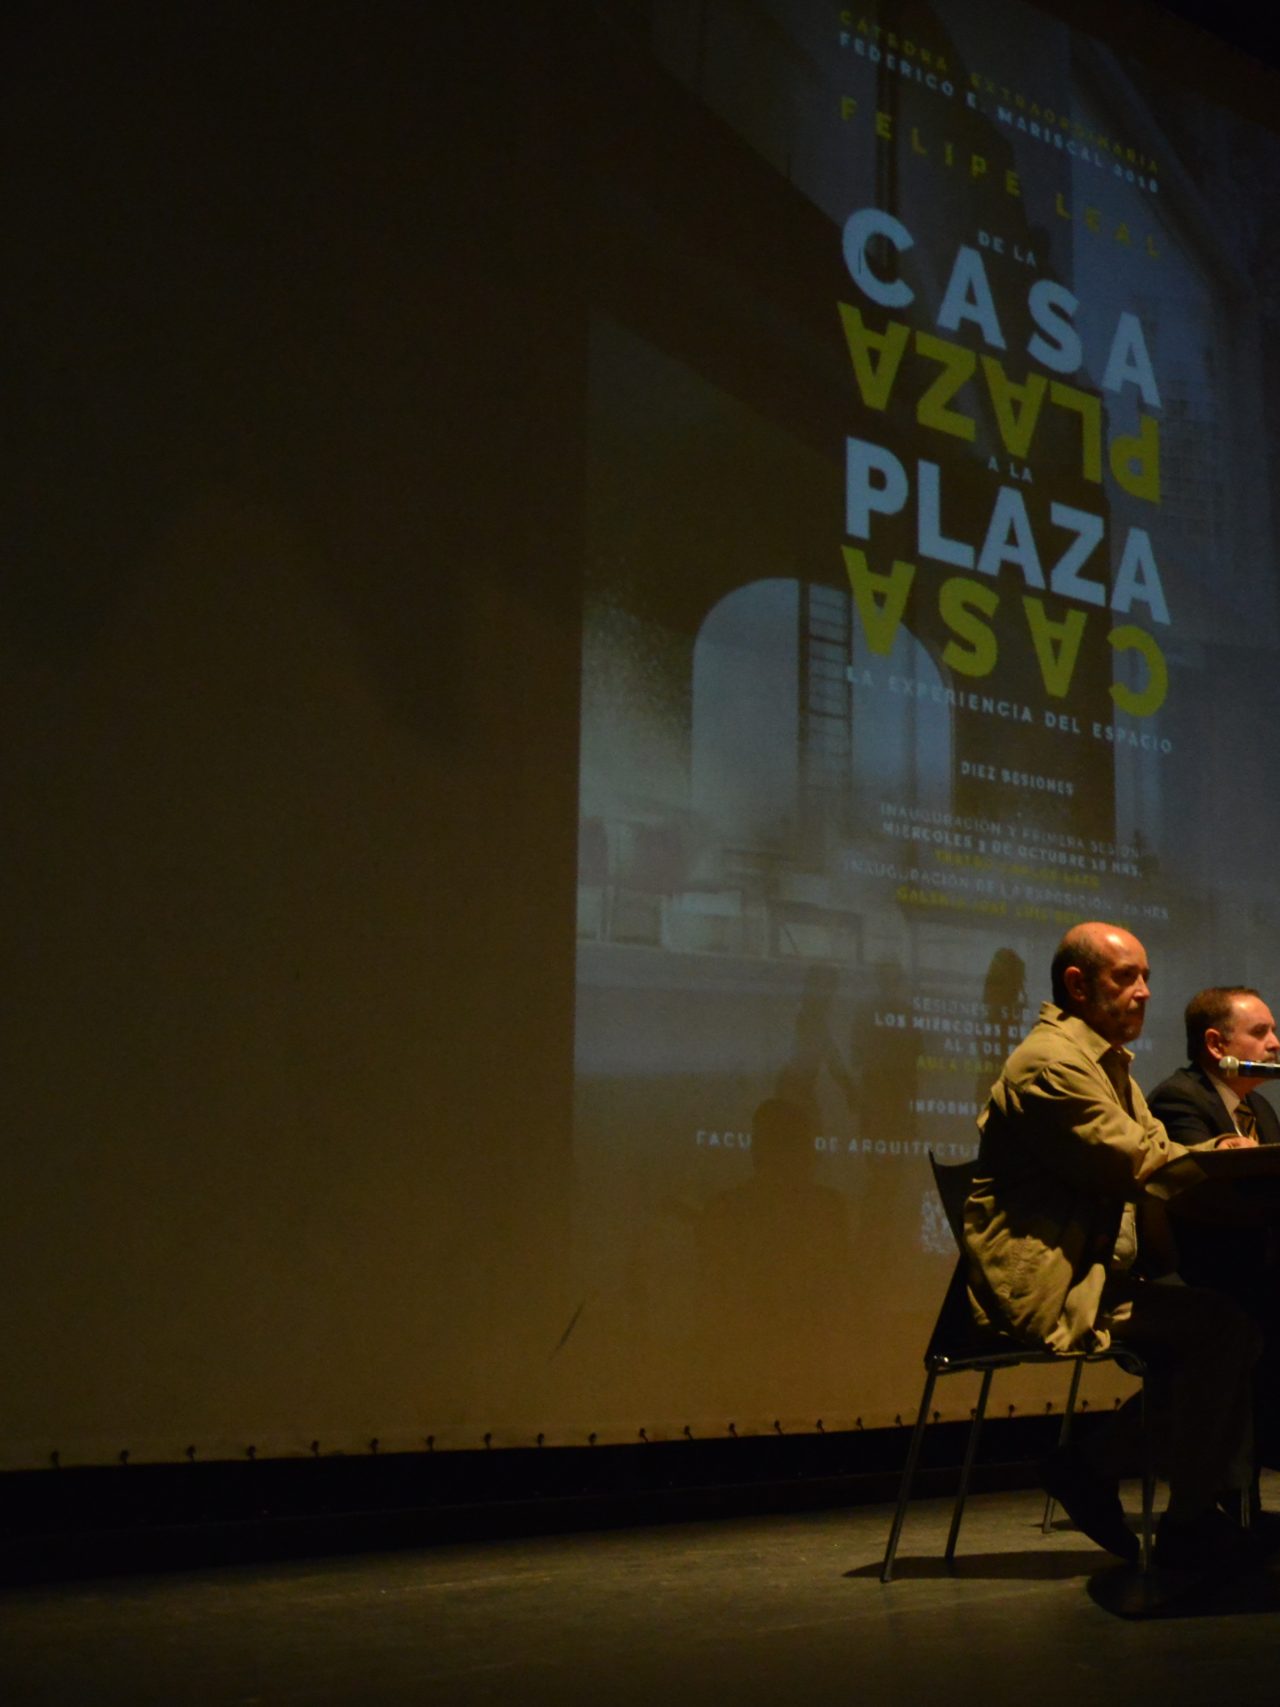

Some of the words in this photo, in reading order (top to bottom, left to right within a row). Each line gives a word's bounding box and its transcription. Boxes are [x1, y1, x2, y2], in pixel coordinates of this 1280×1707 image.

[838, 30, 955, 99] FEDERICO
[996, 103, 1104, 169] MARISCAL
[839, 95, 1021, 200] FELIPE
[1055, 192, 1160, 258] LEAL
[977, 229, 1004, 256] DE
[1013, 243, 1037, 267] LA
[842, 208, 1163, 410] CASA
[987, 456, 1000, 473] A
[1009, 464, 1034, 485] LA
[844, 438, 1172, 627] PLAZA
[846, 666, 875, 689] LA
[888, 674, 1033, 724] EXPERIENCIA
[1045, 711, 1082, 736] DEL
[1092, 722, 1173, 755] ESPACIO
[960, 760, 996, 781] DIEZ
[1001, 766, 1075, 797] SESIONES
[1017, 844, 1086, 870] OCTUBRE
[873, 1011, 907, 1030] LOS
[943, 1037, 964, 1053] AL
[814, 1135, 838, 1153] DE
